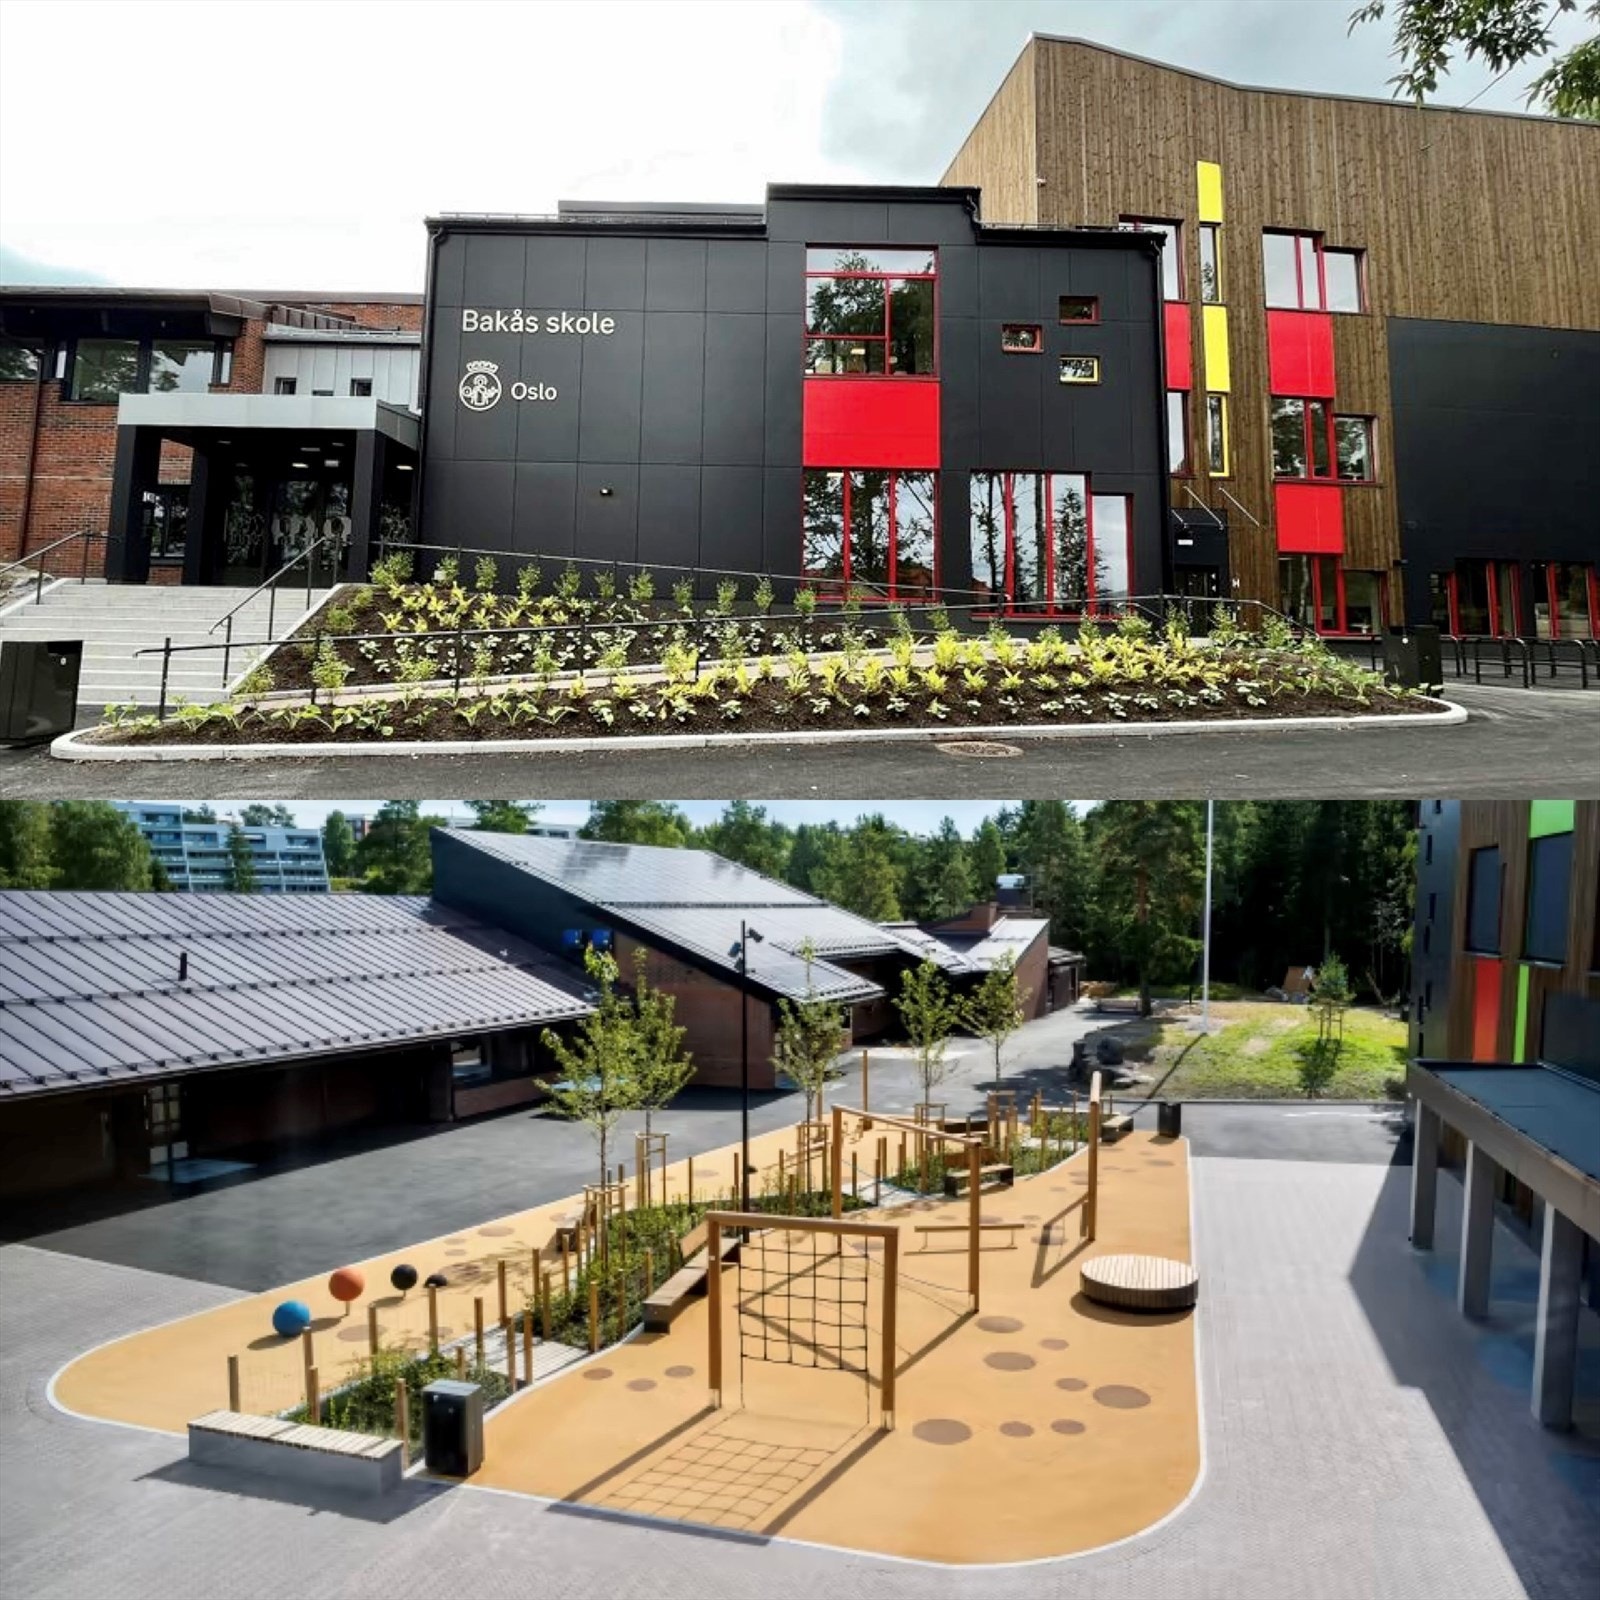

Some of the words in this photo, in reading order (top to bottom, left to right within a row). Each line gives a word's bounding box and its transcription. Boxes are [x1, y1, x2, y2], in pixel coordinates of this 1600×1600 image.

[462, 309, 539, 332] Bakås
[546, 312, 615, 334] skole
[510, 382, 557, 400] Oslo
